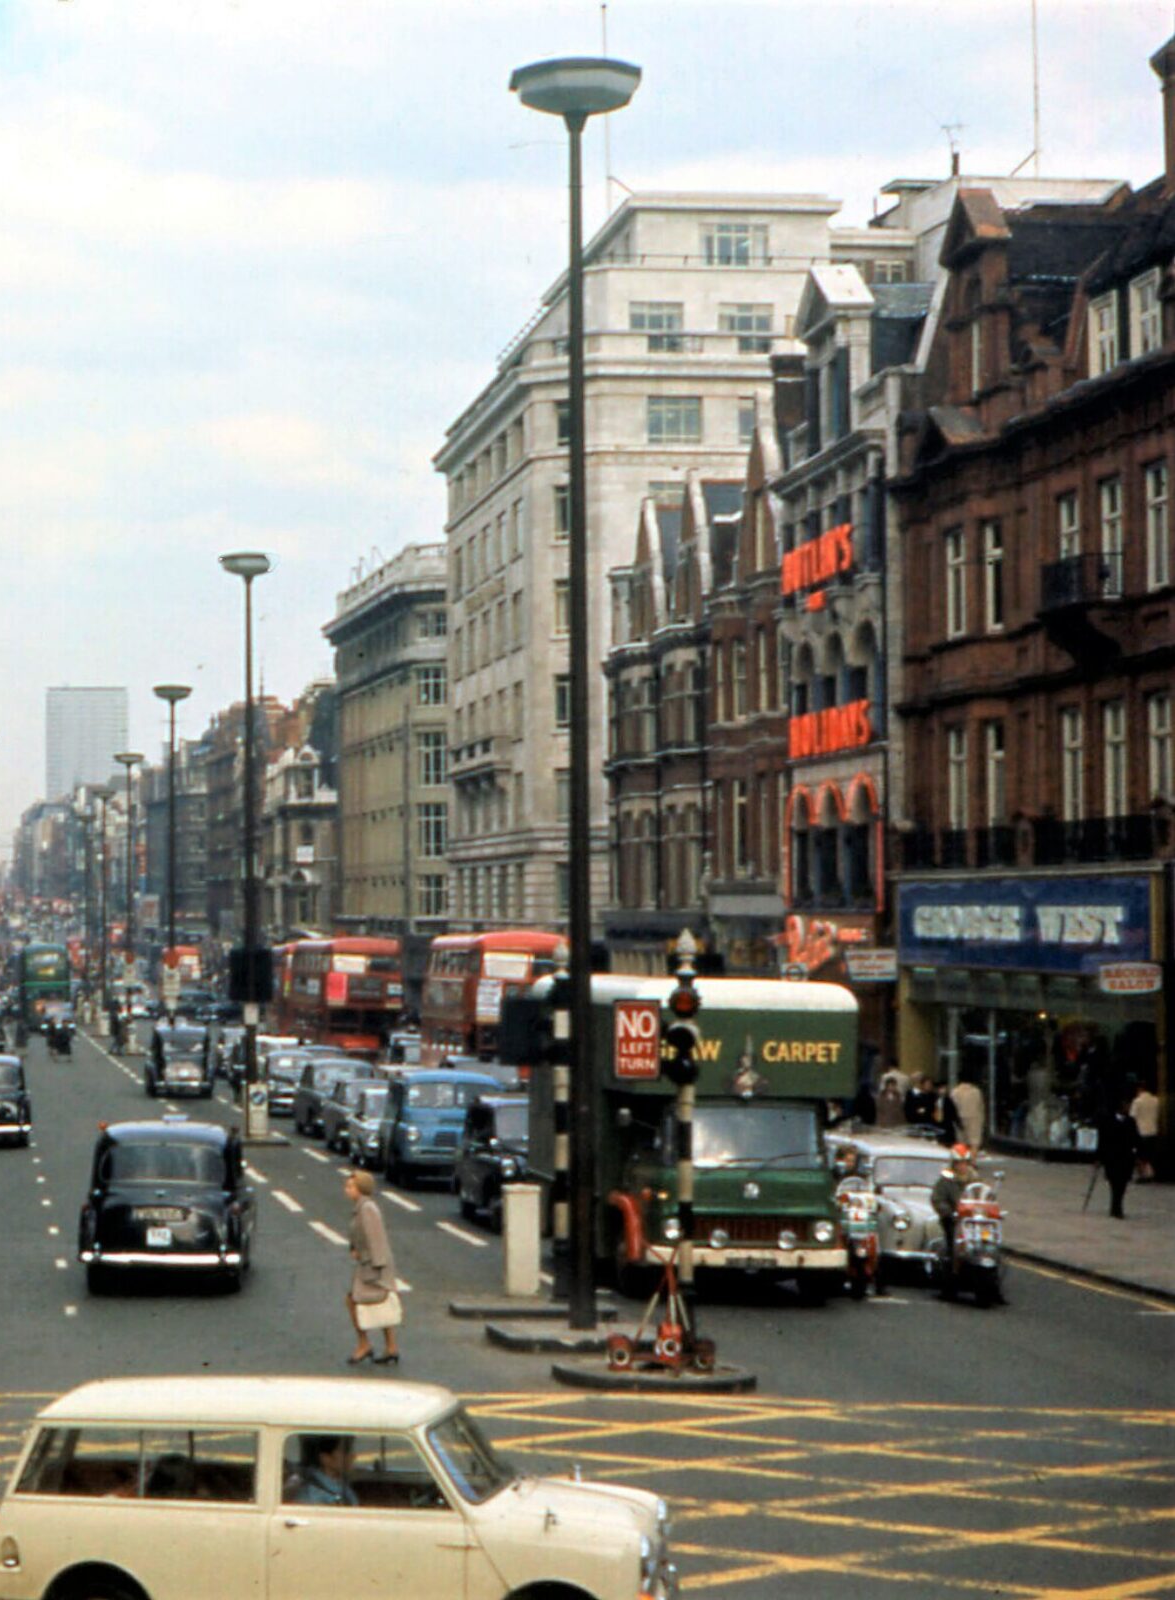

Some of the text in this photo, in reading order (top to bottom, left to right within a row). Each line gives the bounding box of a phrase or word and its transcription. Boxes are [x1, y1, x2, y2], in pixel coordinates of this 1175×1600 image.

[913, 905, 1021, 940] GEORGE
[1036, 905, 1124, 945] WEST
[1103, 967, 1160, 979] RECORD
[1108, 979, 1156, 991] SALON
[617, 1010, 657, 1038] NO
[621, 1042, 653, 1055] LEFT
[762, 1041, 842, 1063] CARPET
[619, 1057, 656, 1070] TURN
